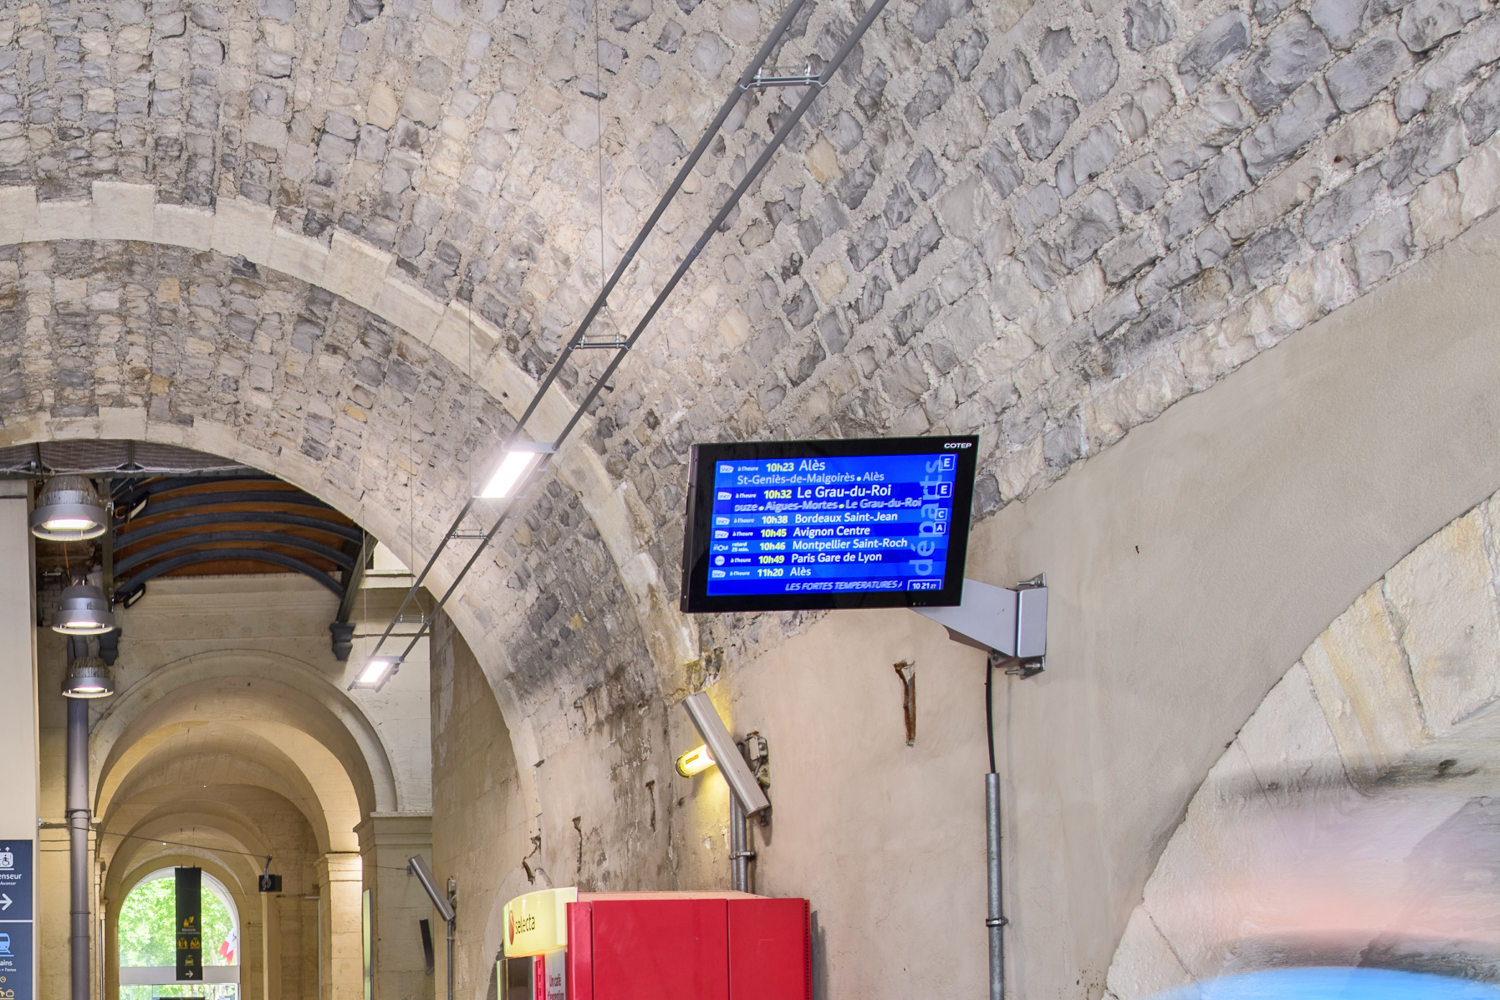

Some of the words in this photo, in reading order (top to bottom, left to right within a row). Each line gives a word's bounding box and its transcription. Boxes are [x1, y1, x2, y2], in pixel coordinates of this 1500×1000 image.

[766, 462, 794, 472] 10h23
[799, 460, 825, 471] Alès
[943, 458, 951, 467] E
[737, 472, 855, 485] St-Geniès-de-Malgoirès
[863, 472, 884, 481] Alès
[764, 490, 792, 499] 10h32
[797, 487, 812, 498] Le
[815, 484, 892, 498] Grau-du-Roi
[940, 485, 948, 494] E
[764, 500, 838, 513] Aigues-Mortes
[846, 499, 858, 509] Le
[860, 497, 922, 508] Grau-du-Roi
[762, 515, 788, 524] 10h38
[795, 513, 841, 524] Bordeaux
[844, 512, 898, 522] Saint-Jean
[909, 459, 943, 576] départs
[760, 528, 787, 538] 10h45
[793, 527, 834, 539] Avignon
[836, 526, 870, 536] Centre
[759, 542, 786, 551] 10h46
[792, 540, 850, 551] Montpellier
[852, 538, 908, 548] Saint-Roch
[758, 555, 785, 564] 10h49
[791, 553, 815, 563] Paris
[818, 553, 841, 562] Gare
[843, 552, 856, 562] de
[858, 552, 882, 564] Lyon
[757, 568, 784, 577] 11h20
[790, 566, 811, 576] Alès
[785, 583, 800, 591] LES
[801, 582, 833, 591] FORTES
[834, 580, 898, 590] TEMPERATURES
[515, 913, 536, 935] selecta
